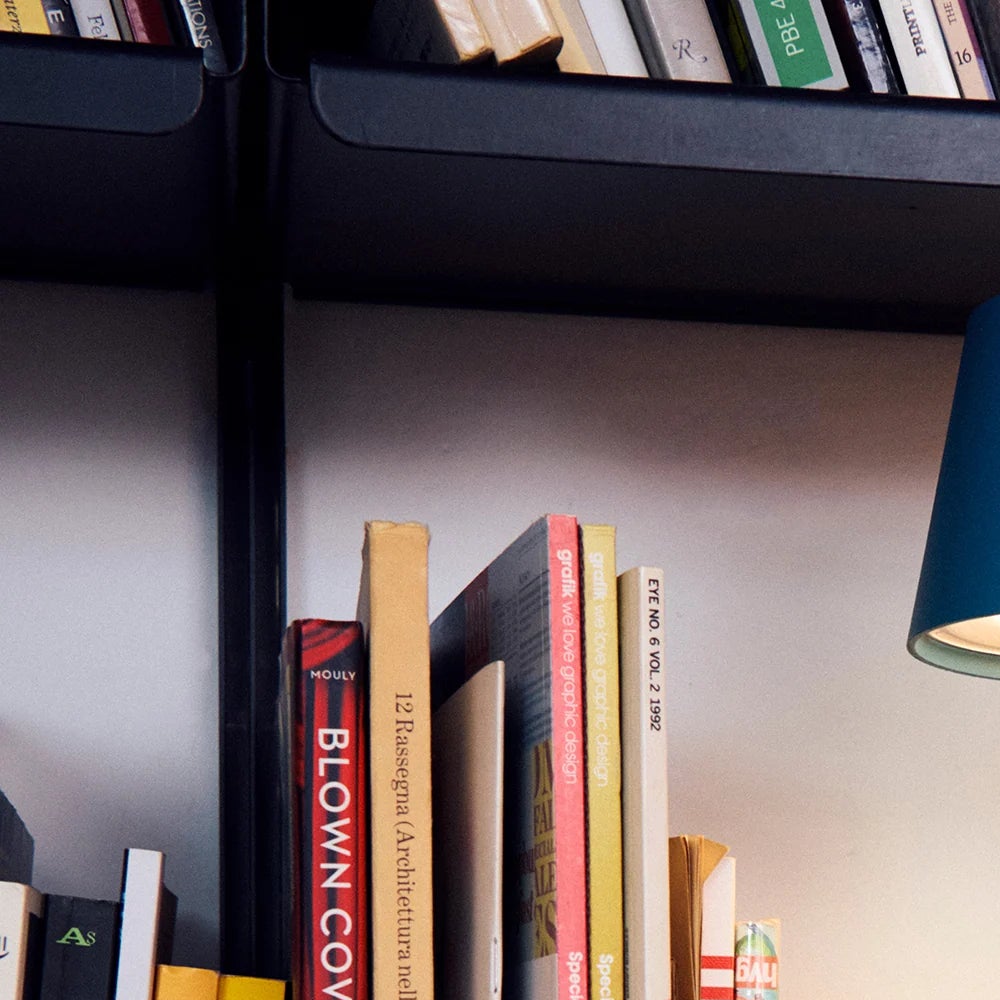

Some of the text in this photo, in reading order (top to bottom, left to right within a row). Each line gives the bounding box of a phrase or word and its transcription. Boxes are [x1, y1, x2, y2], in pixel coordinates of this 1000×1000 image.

[777, 13, 804, 57] PBE
[955, 48, 972, 66] 16
[556, 549, 576, 598] grafik
[588, 551, 608, 601] grafik
[562, 601, 575, 626] we
[562, 629, 578, 663] love
[648, 578, 662, 732] EYE NO. 6 VOL. 2 1992
[310, 669, 356, 681] MOULY
[560, 665, 579, 731] graphic
[395, 692, 414, 714] 12
[391, 718, 415, 817] Rassegna
[562, 732, 580, 785] design
[317, 727, 351, 889] BLOWN
[392, 820, 417, 961] (Architettura
[56, 927, 96, 946] As
